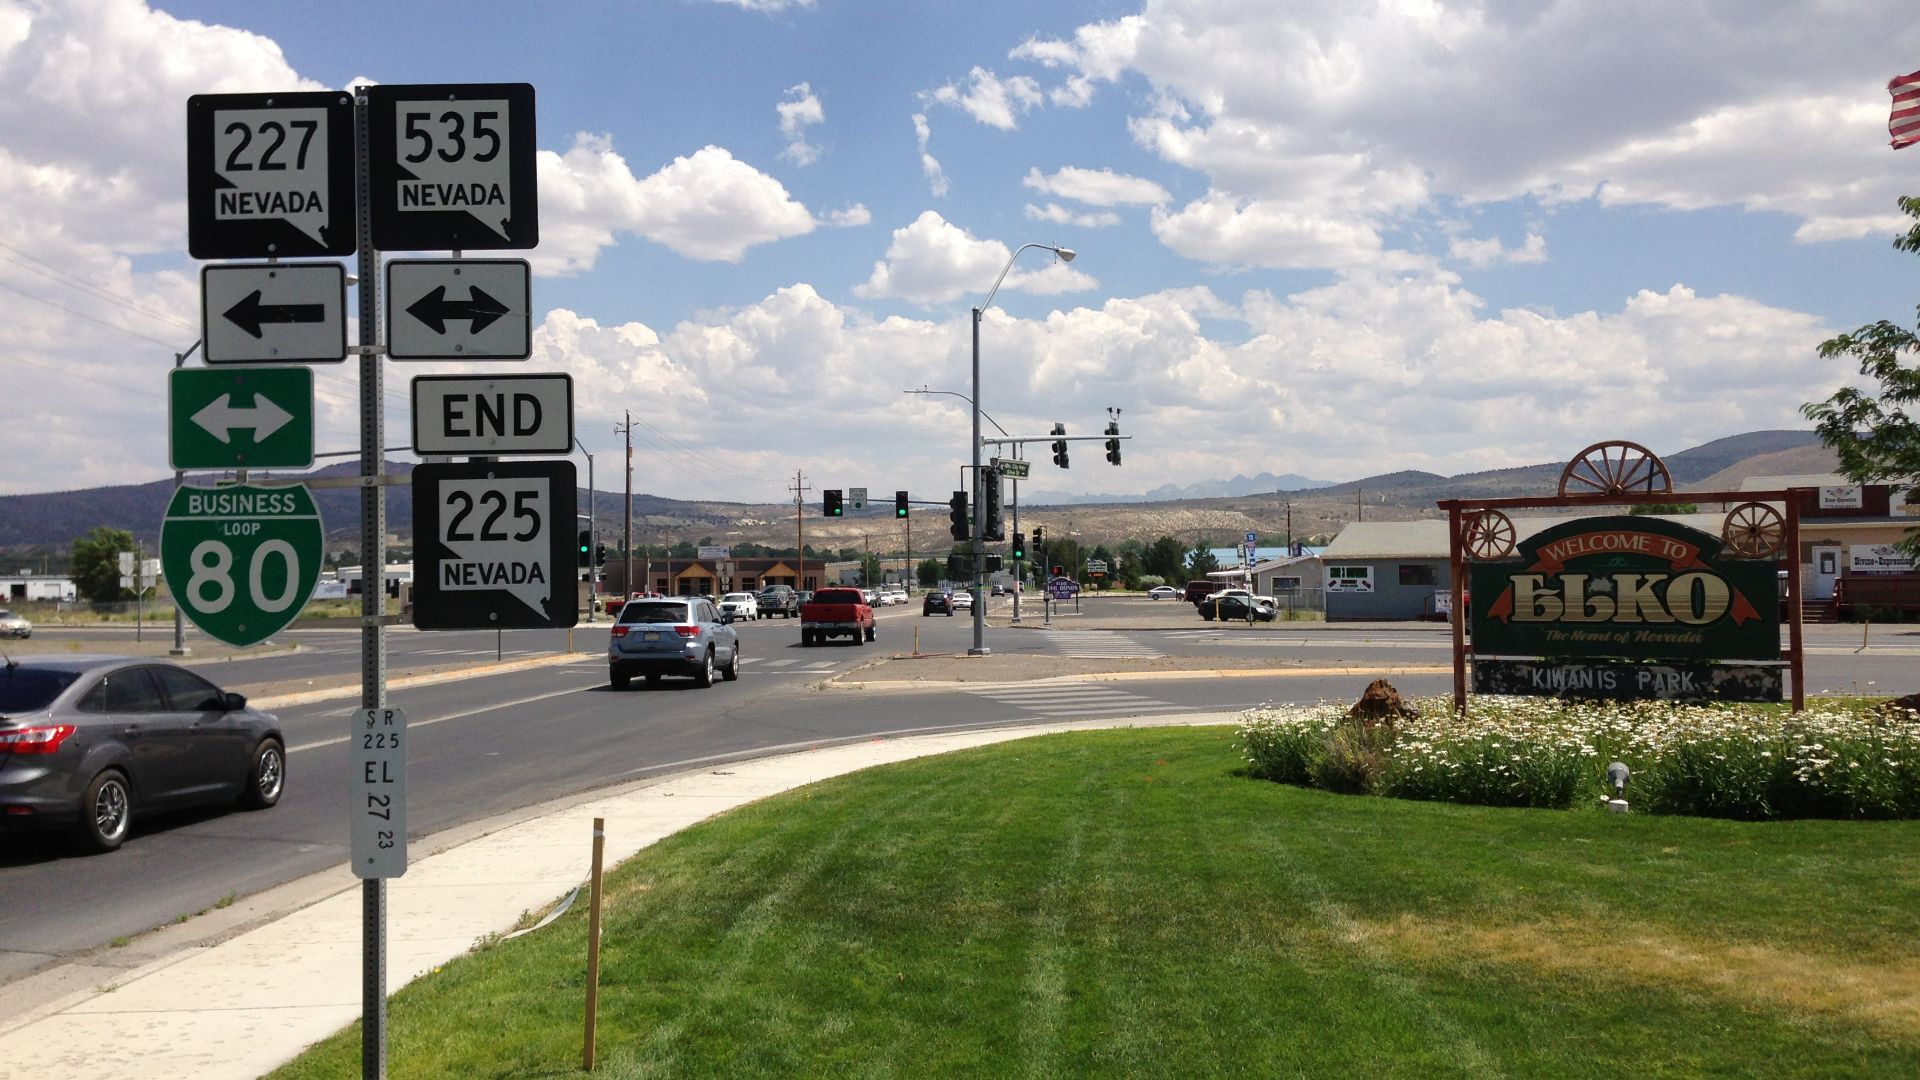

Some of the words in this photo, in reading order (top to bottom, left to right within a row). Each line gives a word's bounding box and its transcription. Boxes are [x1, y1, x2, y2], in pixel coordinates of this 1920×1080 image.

[224, 120, 318, 171] 227
[405, 111, 501, 163] 535
[220, 191, 323, 215] NEVADA
[403, 183, 505, 206] NEVADA
[443, 393, 542, 438] END
[188, 494, 296, 515] BUSINESS
[446, 490, 541, 542] 225
[223, 522, 261, 536] LOOP
[1545, 534, 1651, 562] WELCOME
[1660, 538, 1687, 560] TO
[186, 539, 299, 614] 80
[444, 562, 546, 586] NEVADA
[1509, 572, 1730, 625] ELKO
[1545, 629, 1569, 641] The
[1614, 631, 1630, 644] of
[1634, 630, 1704, 644] Nevada
[1532, 668, 1617, 690] KIWANIS
[1637, 671, 1696, 691] PARK
[364, 733, 399, 749] 225
[365, 761, 394, 783] EL
[368, 793, 390, 821] 27
[378, 830, 394, 850] 23
